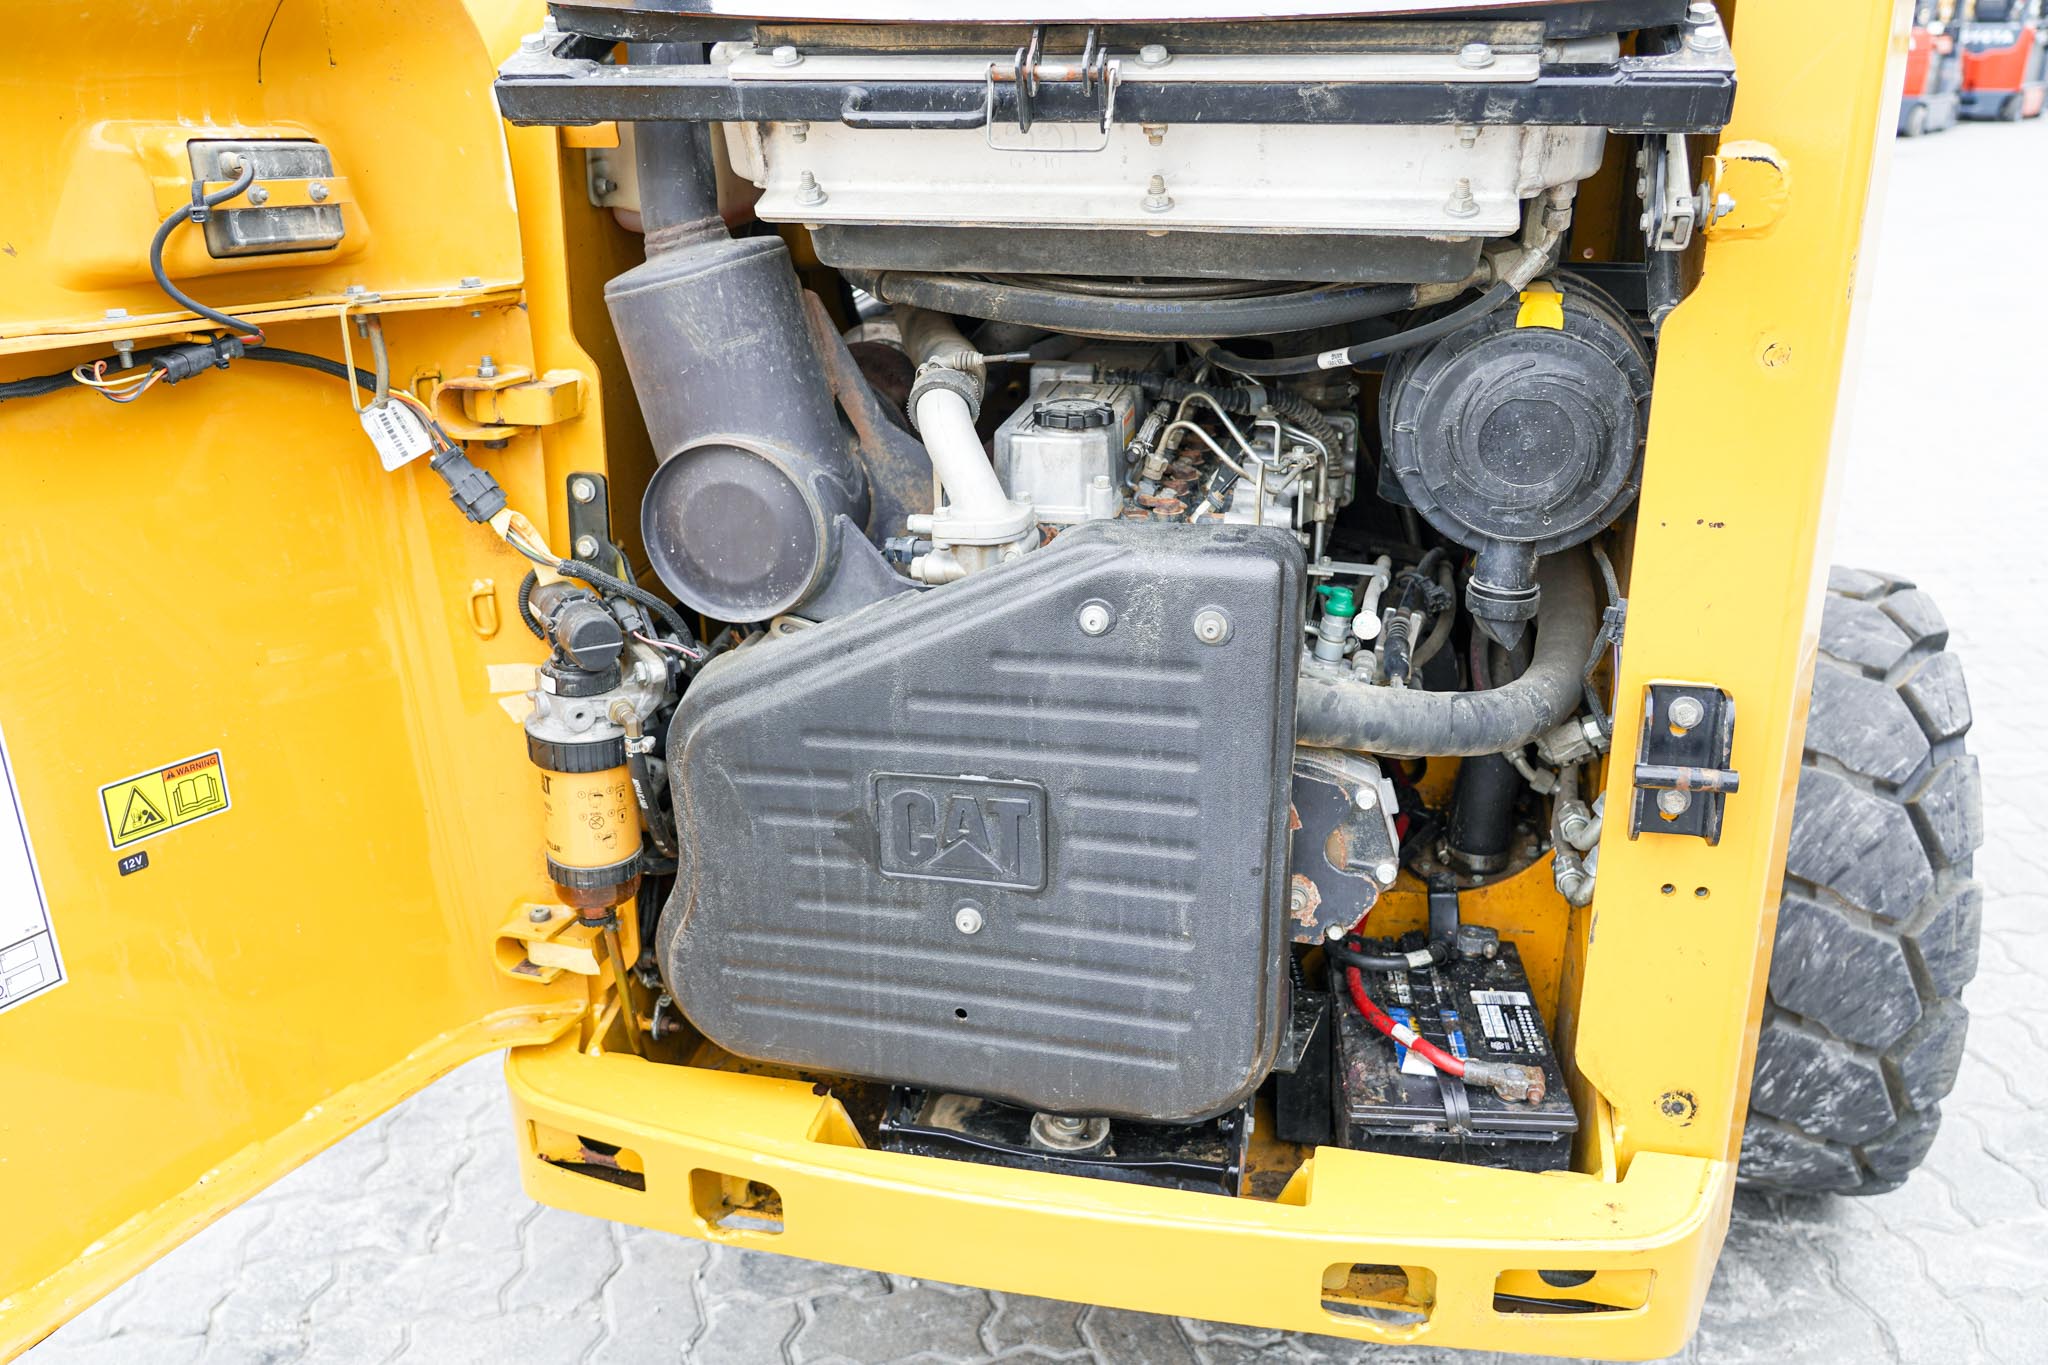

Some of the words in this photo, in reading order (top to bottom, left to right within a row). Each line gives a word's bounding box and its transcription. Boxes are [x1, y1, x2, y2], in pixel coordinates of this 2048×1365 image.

[175, 757, 217, 777] WARNING
[890, 788, 1031, 876] CAT
[122, 855, 143, 870] 12V
